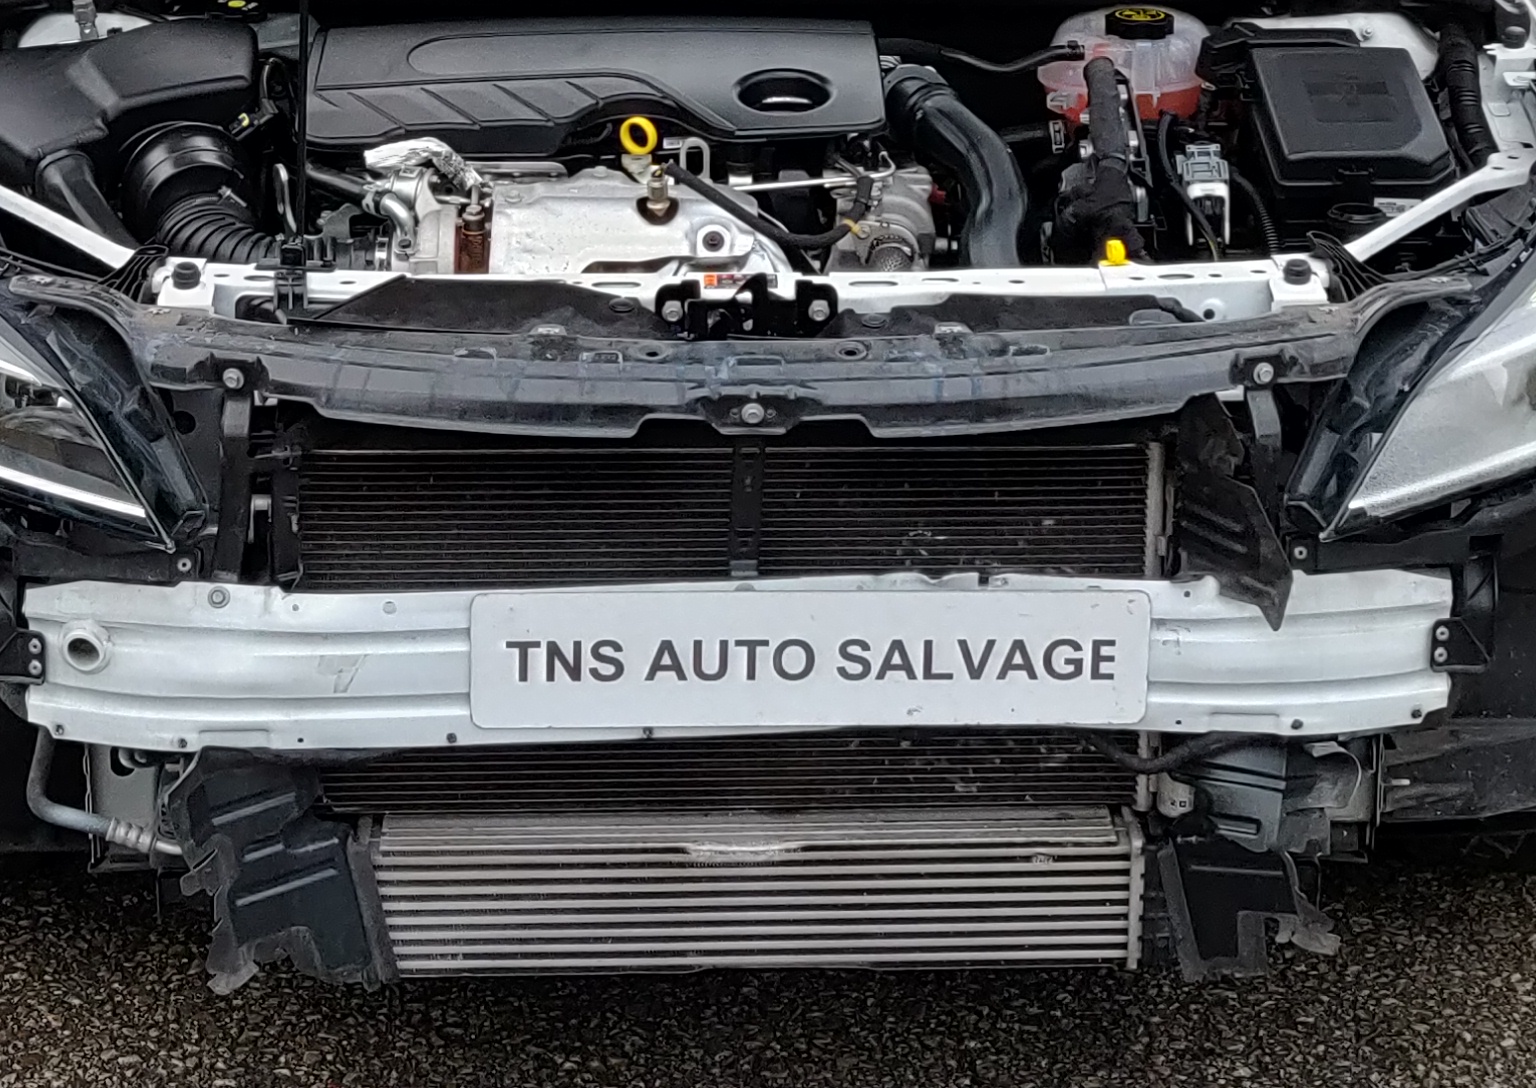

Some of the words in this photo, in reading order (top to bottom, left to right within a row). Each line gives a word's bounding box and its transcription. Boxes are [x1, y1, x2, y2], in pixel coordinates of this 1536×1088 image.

[505, 639, 625, 682] TNS
[645, 639, 816, 682] AUTO
[836, 638, 1117, 681] SALVAGE
